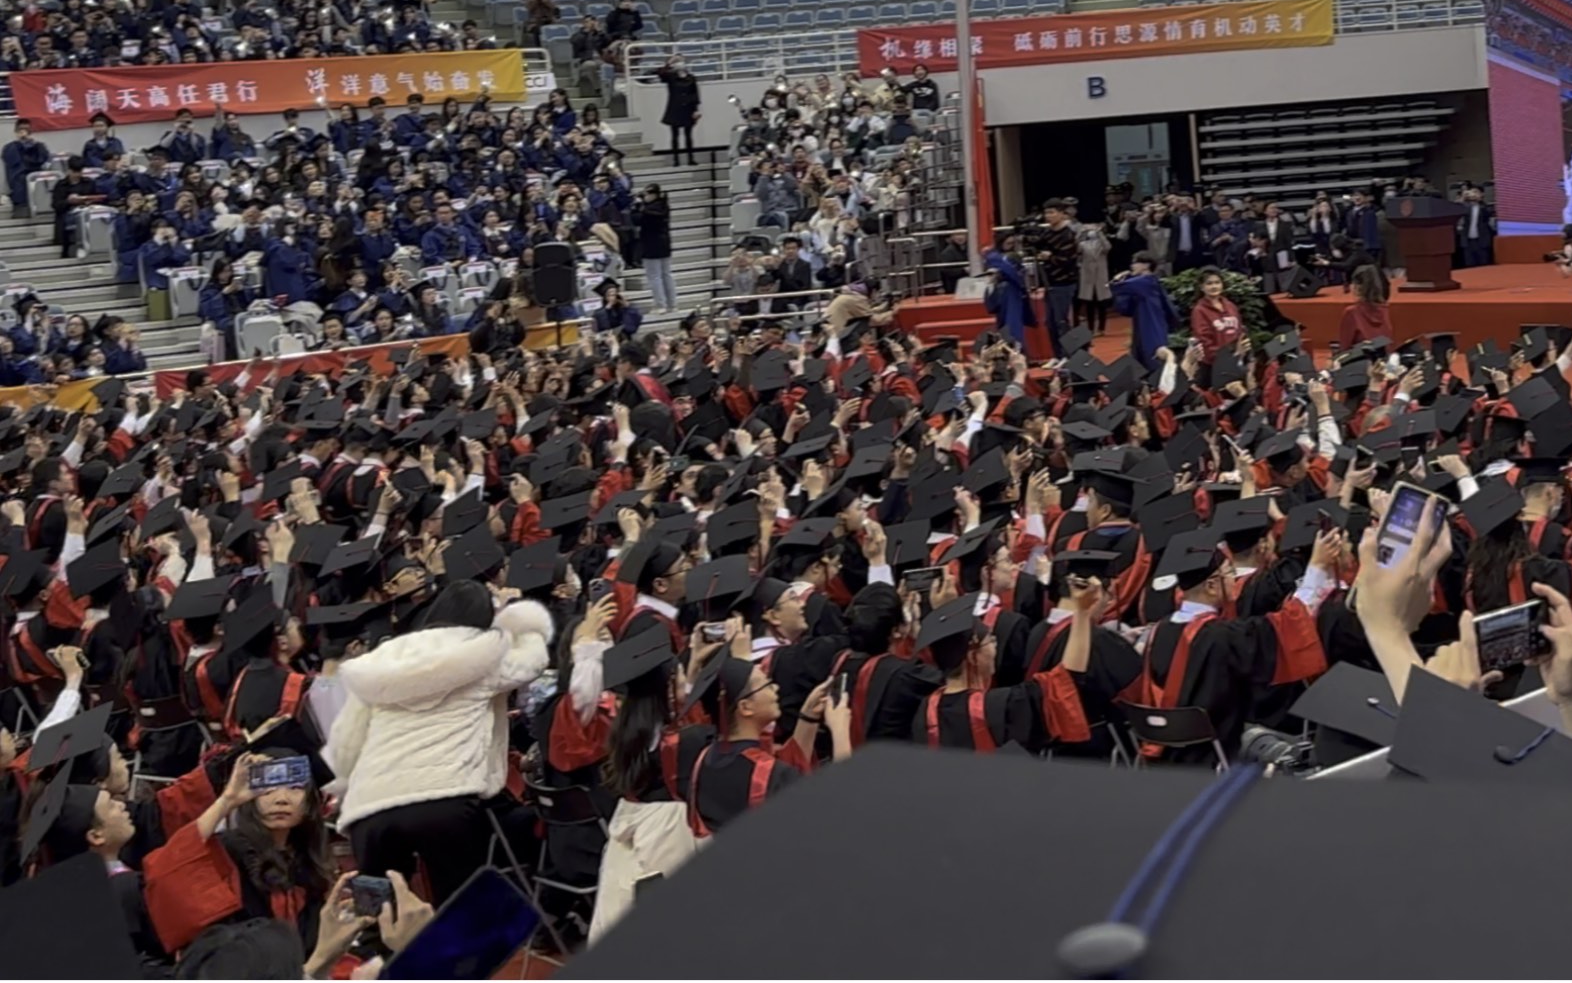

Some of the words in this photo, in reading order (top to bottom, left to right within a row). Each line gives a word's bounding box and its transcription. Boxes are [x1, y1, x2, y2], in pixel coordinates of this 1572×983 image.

[44, 79, 259, 115] 海阔天高任君行
[1087, 76, 1108, 100] B
